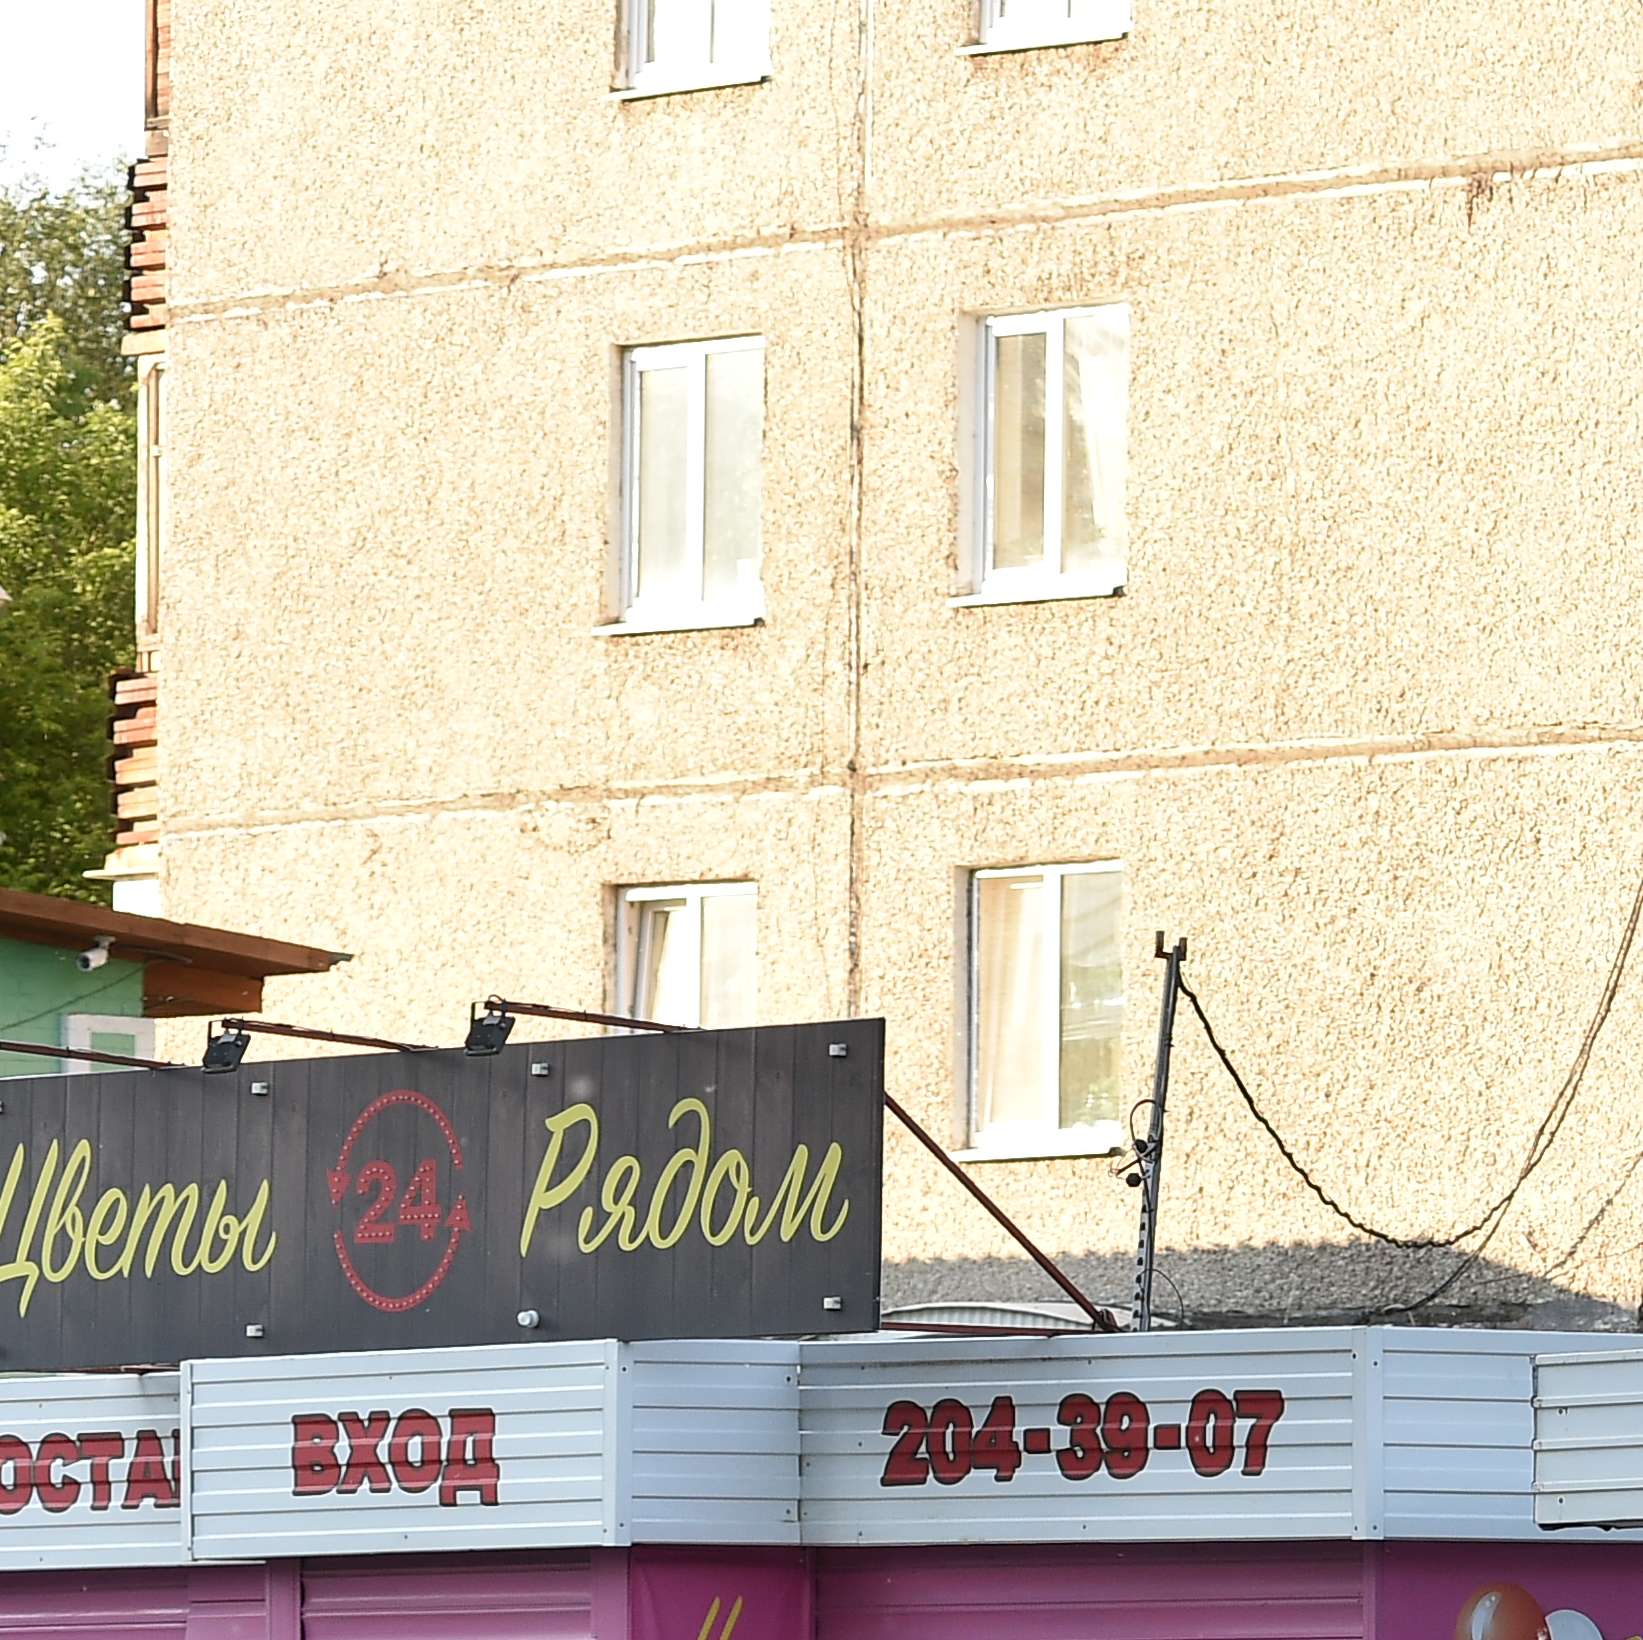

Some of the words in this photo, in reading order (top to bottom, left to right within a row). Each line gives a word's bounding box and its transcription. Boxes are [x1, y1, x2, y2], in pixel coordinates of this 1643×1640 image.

[0, 1138, 277, 1318] Цветы
[353, 1159, 442, 1244] 24
[520, 1097, 850, 1258] Рядом
[0, 1434, 180, 1512] ОСТА
[290, 1408, 501, 1508] ВХОД
[880, 1388, 1285, 1487] 204-39-07
